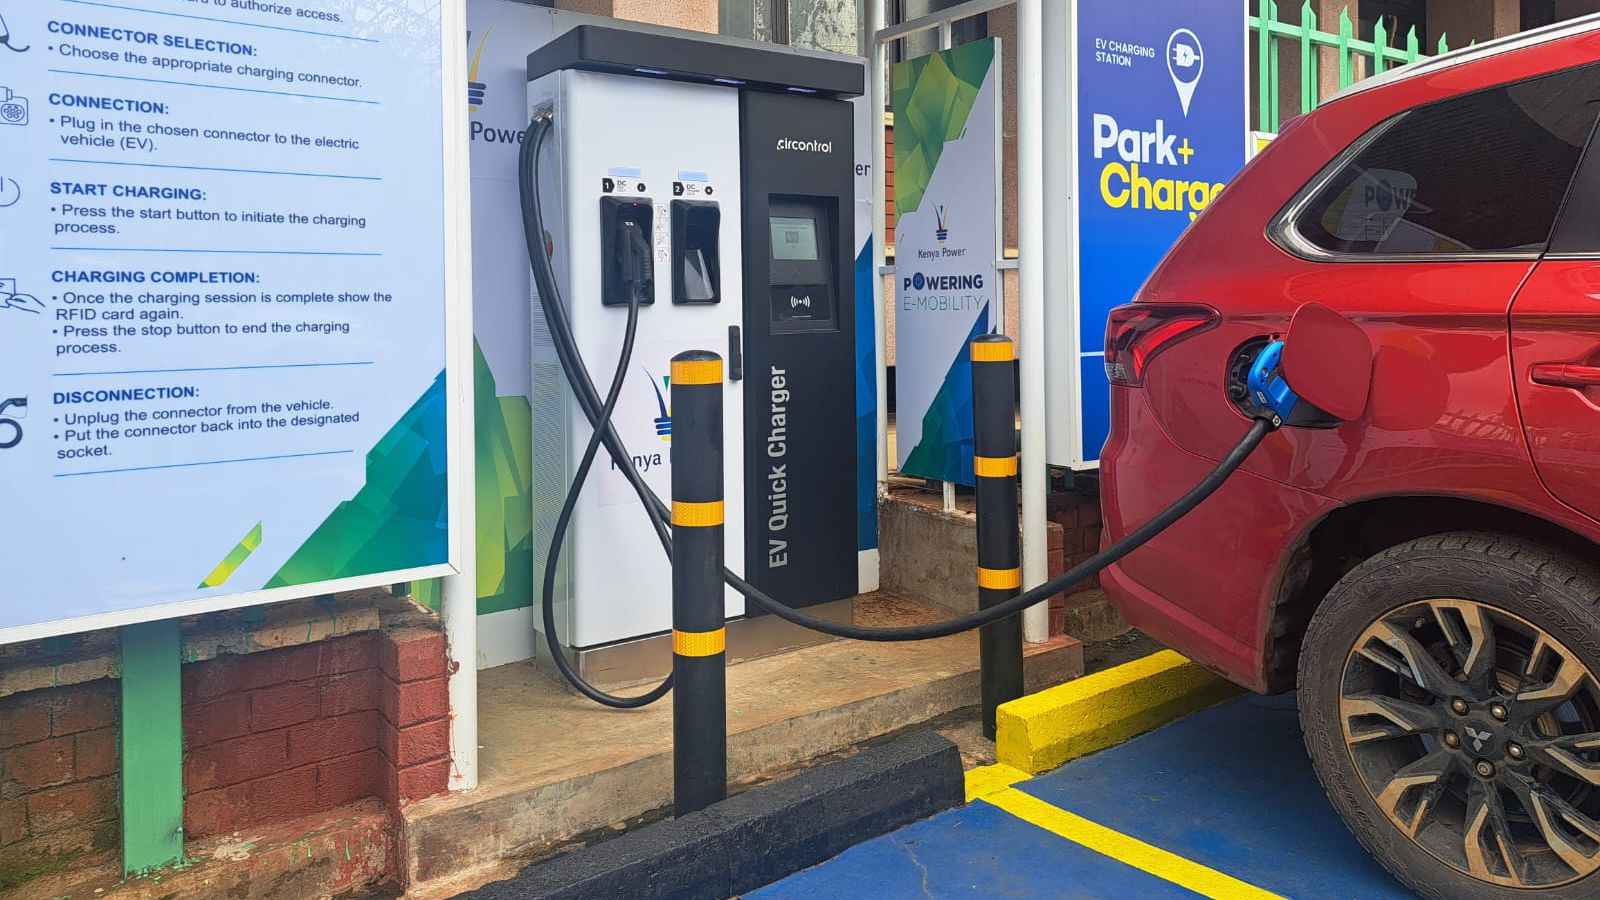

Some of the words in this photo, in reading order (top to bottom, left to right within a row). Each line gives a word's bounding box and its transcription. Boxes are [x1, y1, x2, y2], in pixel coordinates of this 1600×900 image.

[231, 0, 292, 15] authorize
[296, 8, 343, 22] access.
[48, 21, 158, 45] CONNECTOR
[163, 35, 257, 56] SELECTION:
[1095, 38, 1107, 49] EV
[1109, 41, 1155, 58] CHARGING
[59, 44, 119, 61] Choose
[124, 51, 147, 64] the
[152, 57, 232, 73] appropriate
[237, 64, 293, 82] charging
[298, 73, 362, 87] connector.
[1095, 51, 1132, 67] STATION
[49, 93, 168, 114] CONNECTION:
[61, 115, 95, 132] Plug
[101, 119, 113, 131] in
[119, 120, 142, 133] the
[147, 123, 198, 137] chosen
[203, 130, 271, 142] connector
[275, 133, 287, 144] to
[291, 134, 311, 145] the
[315, 136, 359, 149] electric
[471, 121, 527, 144] Powe
[60, 134, 115, 147] vehicle
[120, 136, 157, 152] (EV).
[777, 138, 832, 152] circontrol
[50, 182, 108, 196] START
[113, 185, 206, 200] CHARGING:
[62, 204, 106, 217] Press
[111, 206, 135, 218] the
[139, 208, 172, 219] start
[176, 208, 220, 221] button
[225, 211, 237, 222] to
[242, 211, 285, 223] initiate
[288, 213, 309, 224] the
[313, 214, 366, 228] charging
[55, 223, 120, 235] process.
[918, 249, 940, 261] Kenya
[943, 248, 967, 257] Power
[51, 270, 145, 283] CHARGING
[150, 271, 260, 283] COMPLETION:
[904, 272, 984, 291] POWERING
[63, 292, 104, 304] Once
[110, 292, 133, 303] the
[138, 292, 200, 306] charging
[205, 292, 256, 303] session
[261, 292, 271, 302] is
[276, 292, 334, 305] complete
[338, 292, 370, 303] show
[373, 292, 392, 302] the
[904, 296, 984, 310] E-MOBILITY
[56, 308, 96, 320] RFID
[102, 308, 134, 320] card
[139, 308, 183, 322] again.
[64, 325, 108, 337] Press
[113, 325, 136, 336] the
[141, 325, 172, 338] stop
[177, 324, 220, 335] button
[225, 323, 238, 334] to
[242, 322, 267, 333] end
[271, 322, 291, 333] the
[296, 321, 349, 334] charging
[56, 344, 121, 357] process.
[53, 386, 199, 405] DISCONNECTION:
[65, 412, 119, 426] Unplug
[125, 410, 147, 421] the
[152, 406, 223, 420] connector
[226, 404, 257, 415] from
[261, 402, 282, 413] the
[286, 399, 333, 411] vehicle.
[767, 366, 790, 458] Charger
[65, 429, 91, 442] Put
[96, 428, 119, 440] the
[124, 424, 197, 438] connector
[201, 420, 233, 432] back
[238, 419, 262, 430] into
[266, 417, 287, 428] the
[291, 411, 359, 427] designated
[57, 445, 112, 459] socket.
[611, 453, 662, 472] nya
[768, 464, 789, 531] Quick
[768, 539, 788, 569] EV
